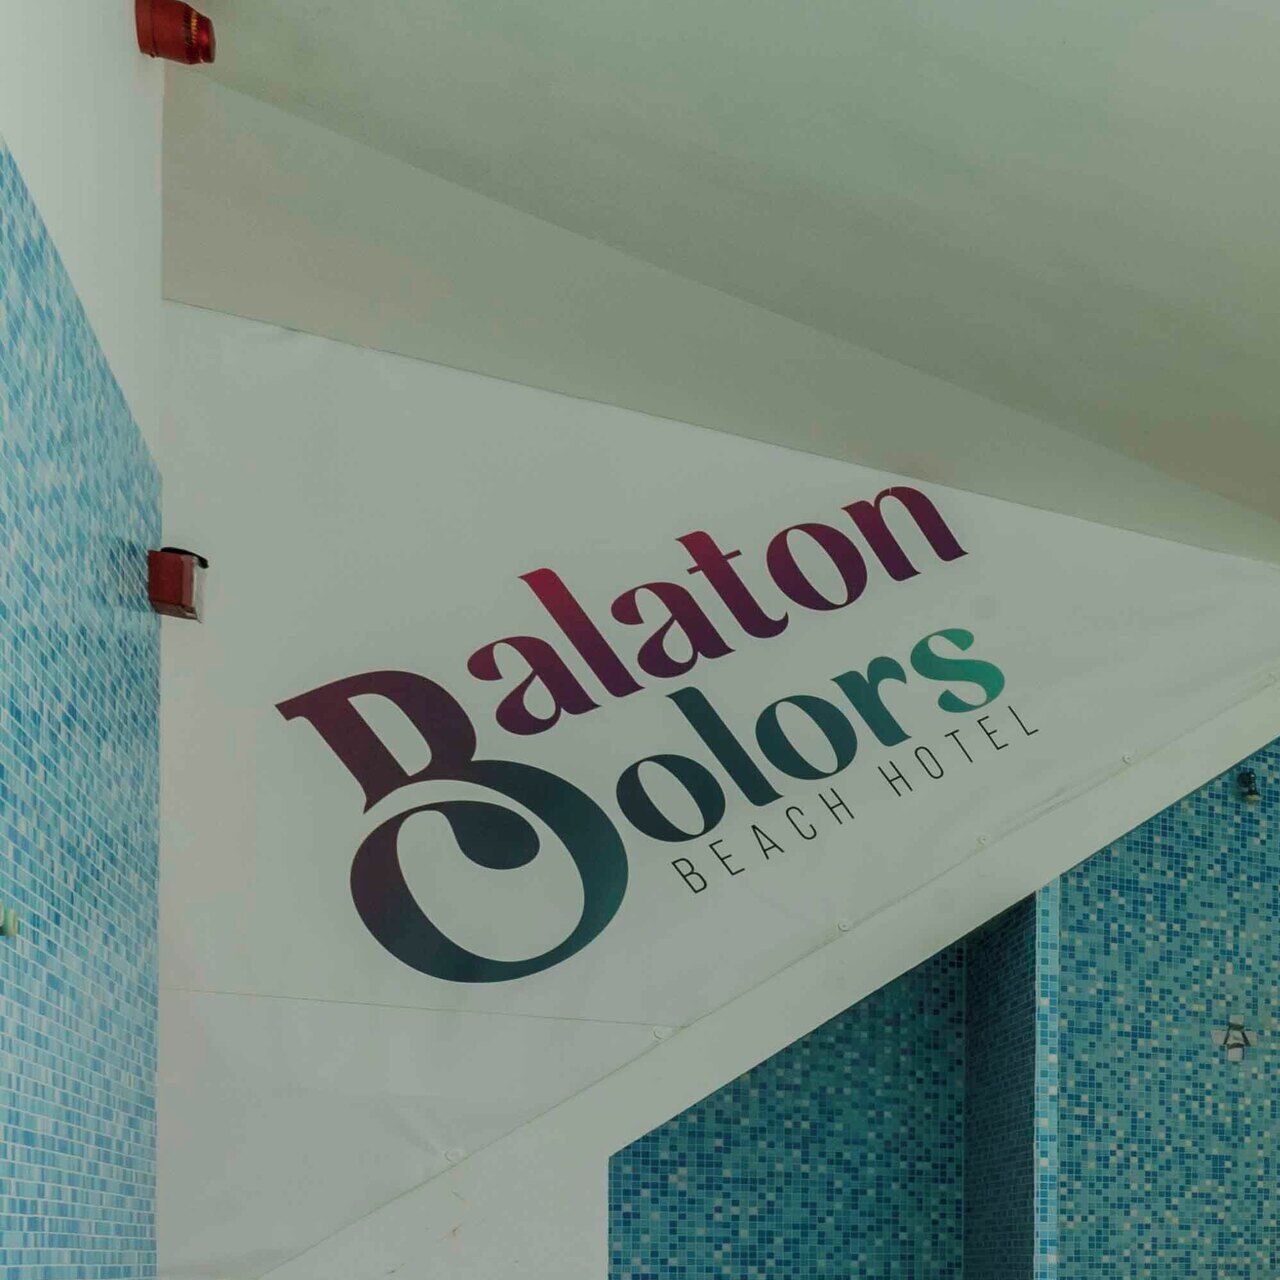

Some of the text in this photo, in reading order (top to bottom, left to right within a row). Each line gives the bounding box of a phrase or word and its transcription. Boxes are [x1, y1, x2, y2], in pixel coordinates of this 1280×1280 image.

[275, 487, 968, 814] Balaton
[350, 629, 1005, 983] Colors
[671, 705, 1039, 894] BEACH HOTEL
